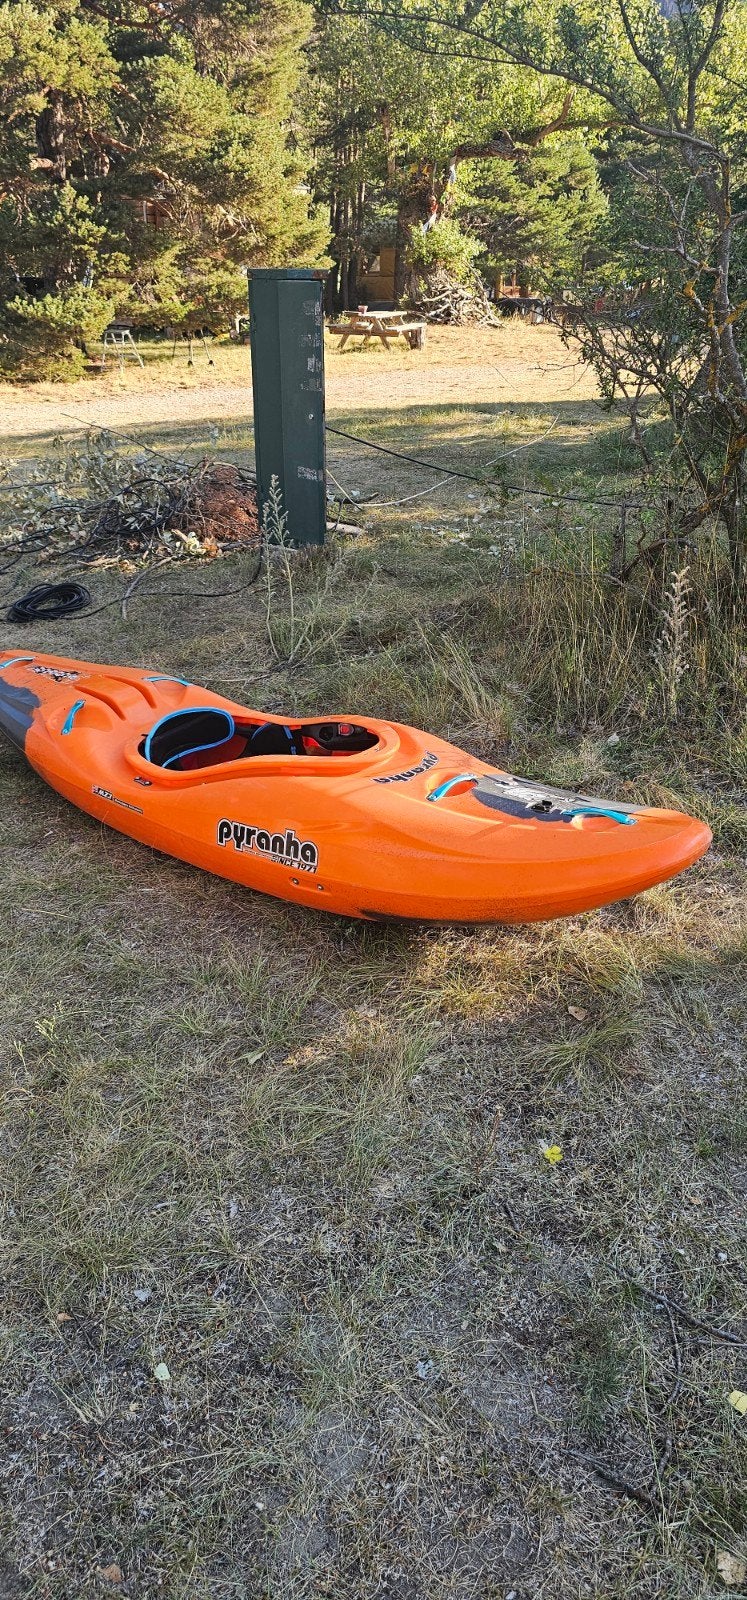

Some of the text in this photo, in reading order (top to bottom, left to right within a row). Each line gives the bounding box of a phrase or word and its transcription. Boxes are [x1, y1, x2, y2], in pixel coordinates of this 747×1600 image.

[371, 749, 439, 785] pyranha
[217, 818, 319, 867] pyranha
[297, 862, 318, 874] 1971
